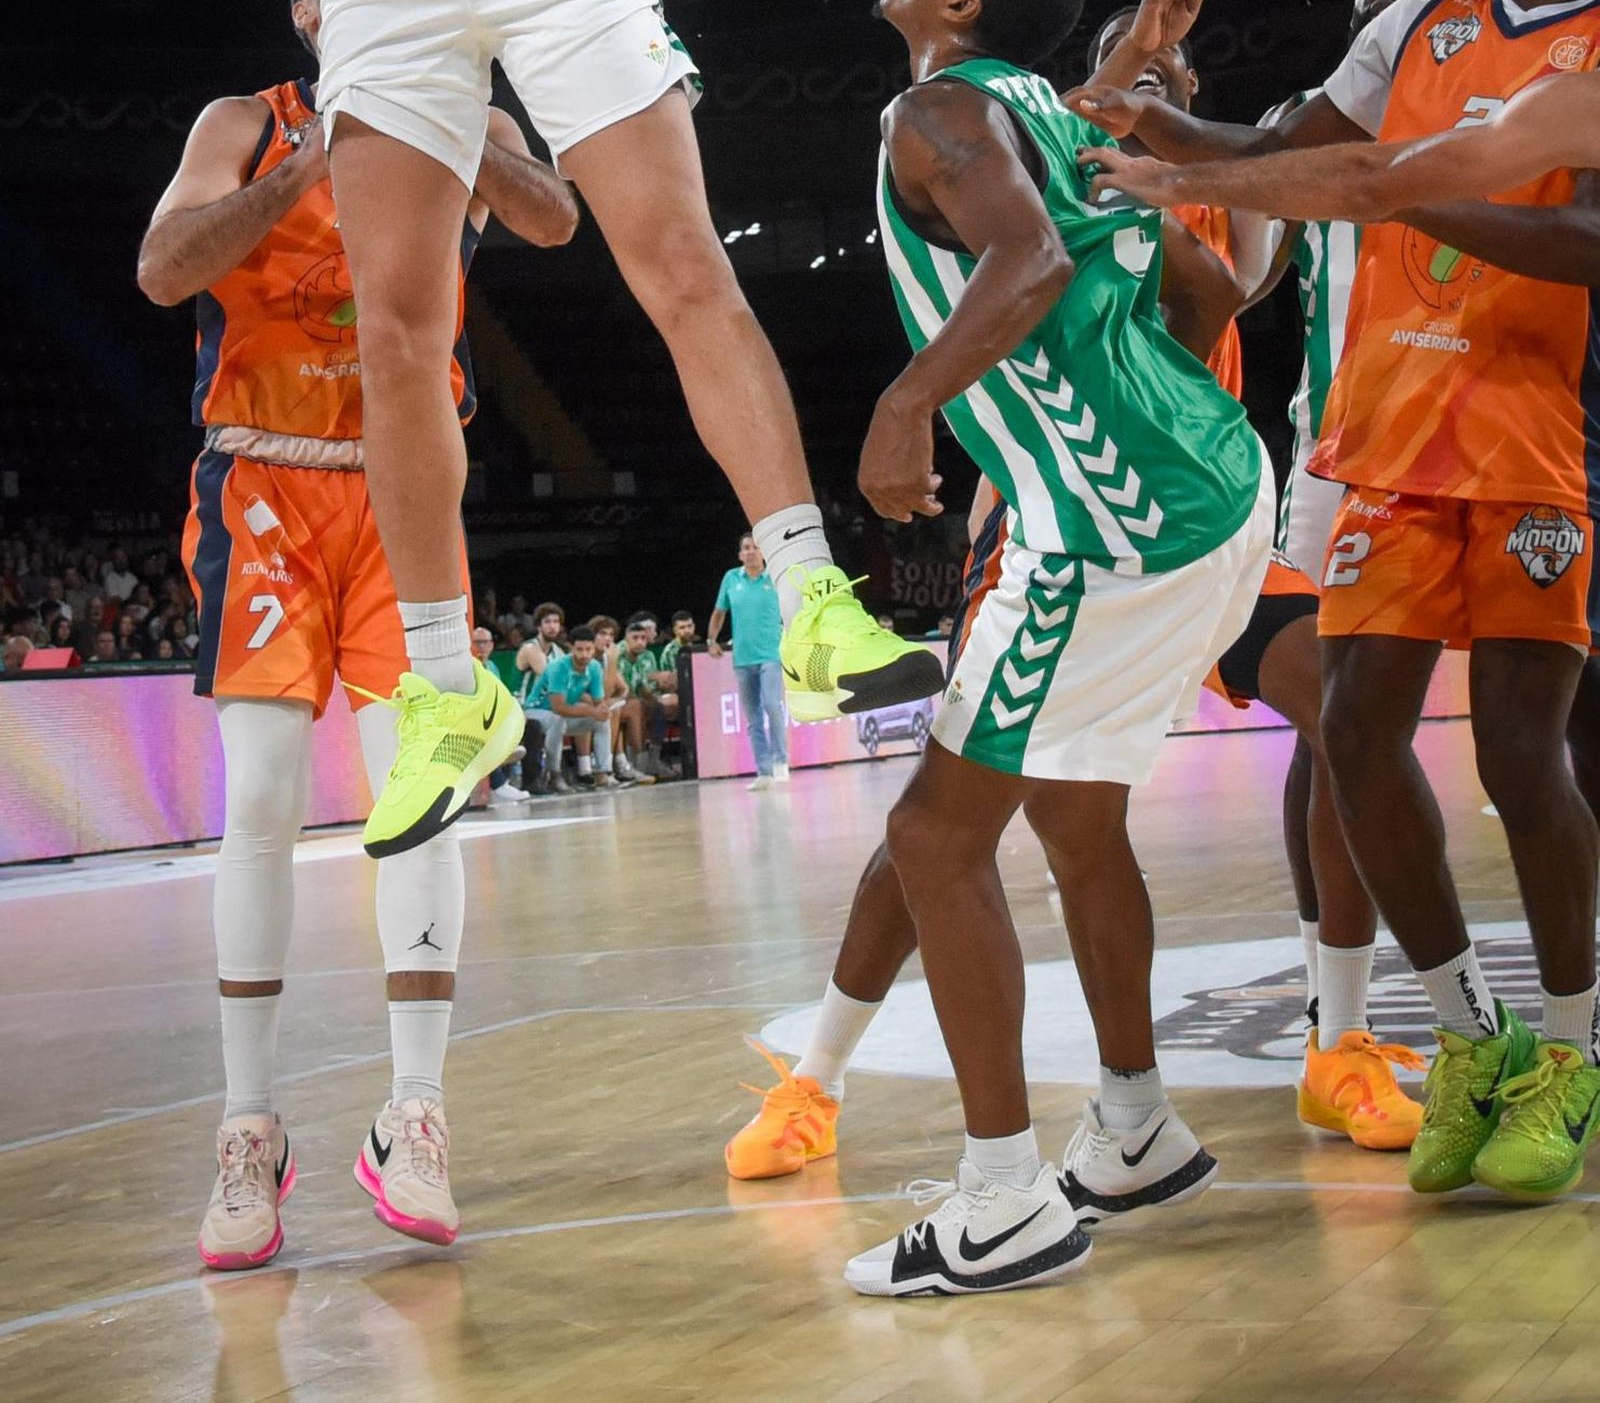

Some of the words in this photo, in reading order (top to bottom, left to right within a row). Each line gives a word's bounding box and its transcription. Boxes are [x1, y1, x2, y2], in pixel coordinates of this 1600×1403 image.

[1390, 329, 1470, 353] AVISERRAO
[1424, 321, 1455, 334] GRUPO
[1323, 531, 1371, 587] 2
[247, 594, 285, 649] 7
